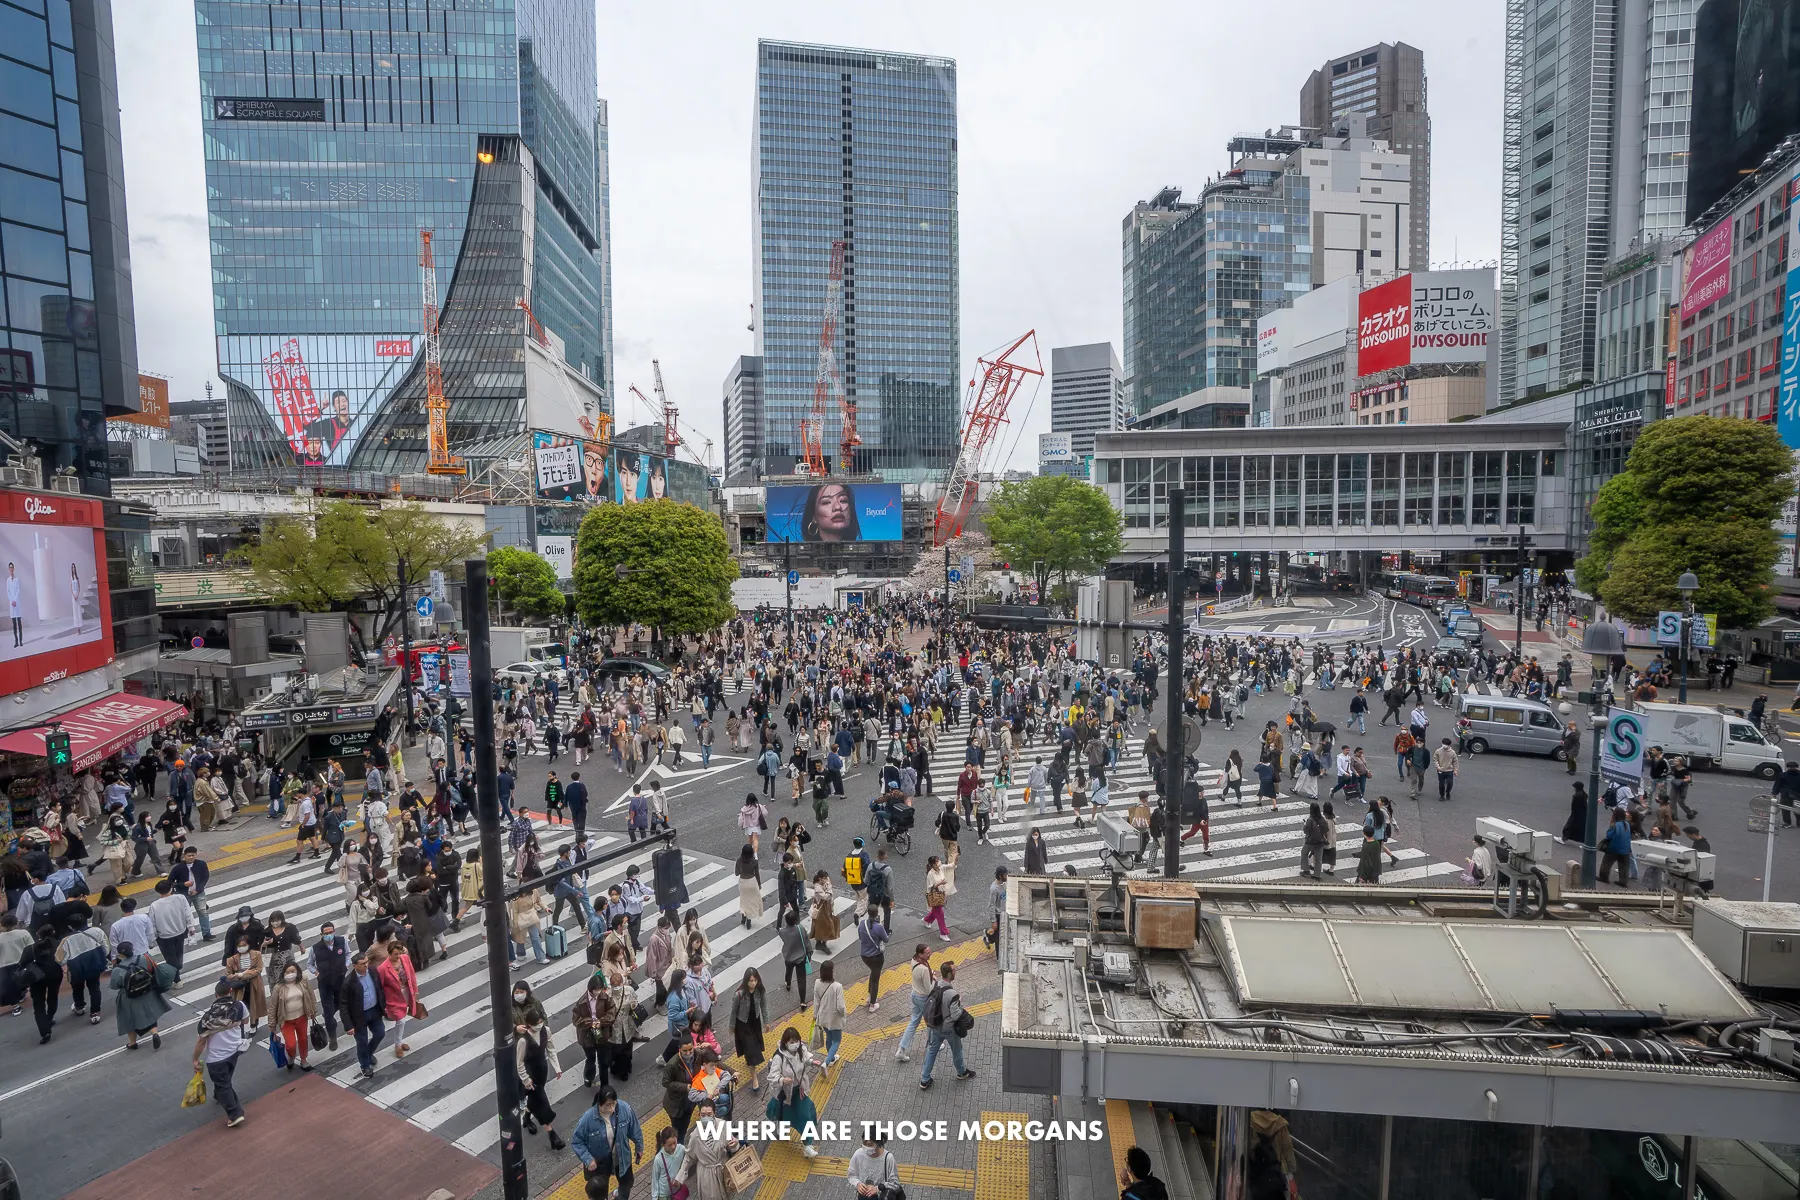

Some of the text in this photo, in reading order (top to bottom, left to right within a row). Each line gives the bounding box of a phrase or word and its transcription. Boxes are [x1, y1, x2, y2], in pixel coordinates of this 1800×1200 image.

[236, 101, 275, 109] SHIBUYA
[236, 110, 284, 118] SCRAMBLE
[1703, 227, 1730, 252] 品川スキン
[1701, 242, 1727, 267] クリニック
[1414, 286, 1474, 302] ココロの
[1686, 273, 1727, 313] 品川美容外科
[1413, 302, 1491, 319] ボリューム、
[1360, 304, 1409, 337] カラオケ
[1413, 318, 1492, 332] あげていこう。
[1360, 323, 1410, 350] JOYSOUND
[377, 341, 412, 354] バイトル
[1580, 409, 1643, 429] MARK CITY
[1594, 406, 1624, 417] SHIBUYA
[541, 451, 565, 463] ソフトバンク
[542, 463, 577, 484] デビュー割
[866, 508, 887, 517] Beyond
[545, 545, 565, 555] Olive
